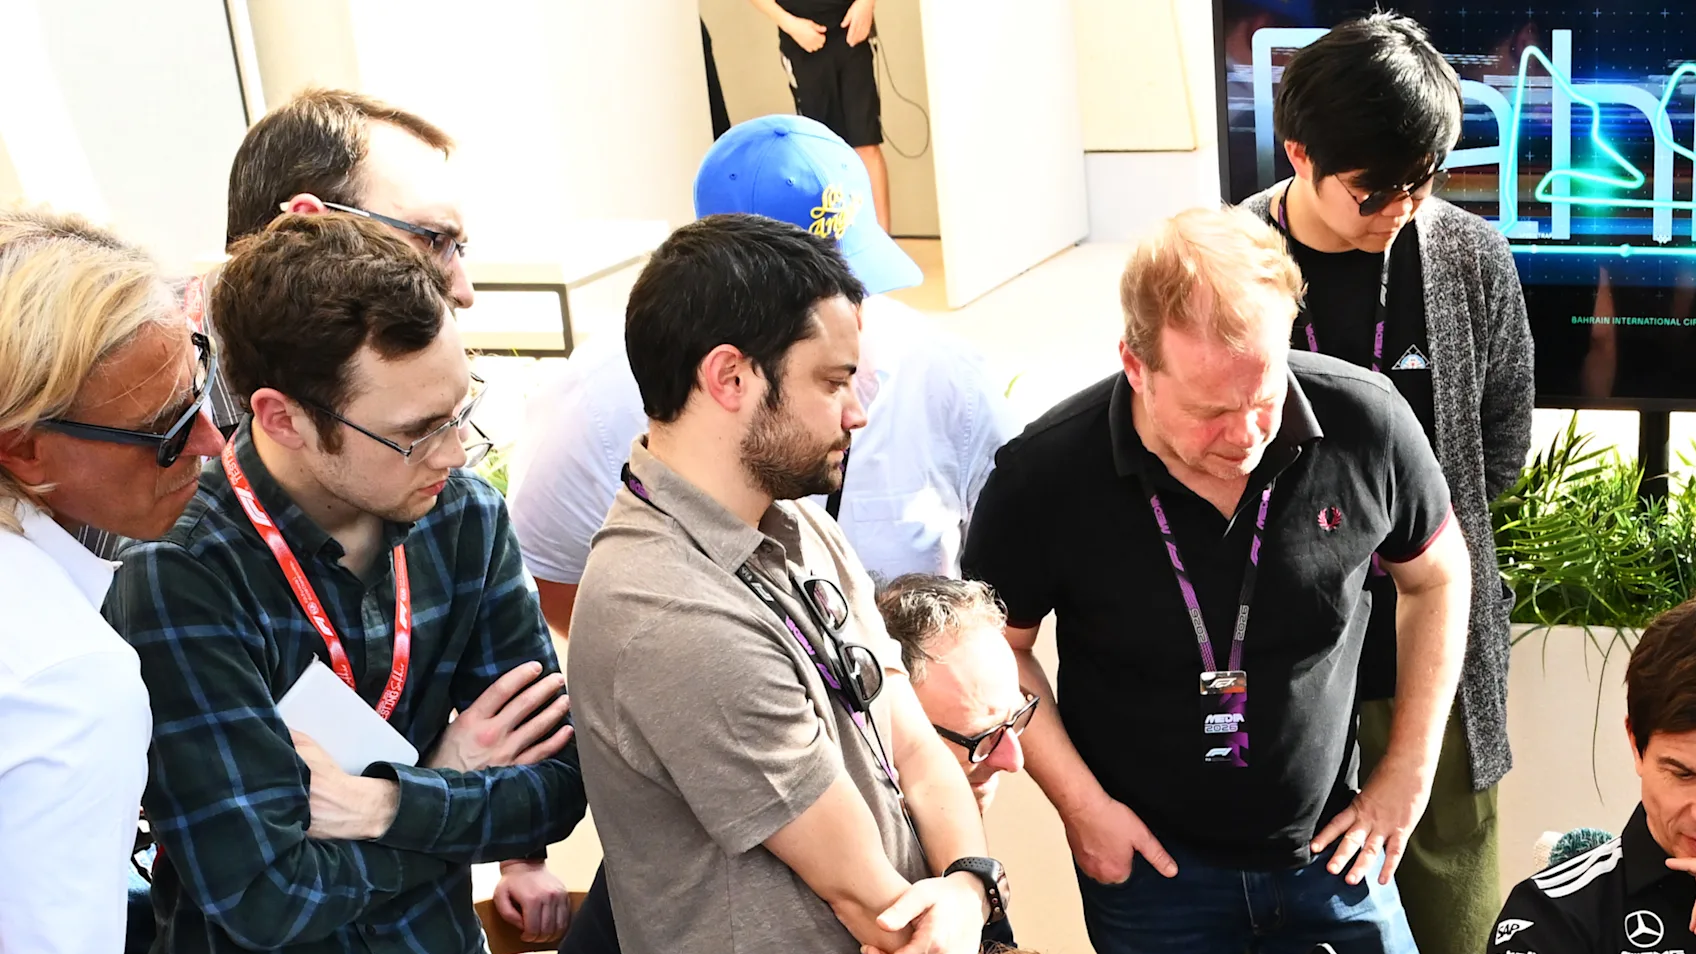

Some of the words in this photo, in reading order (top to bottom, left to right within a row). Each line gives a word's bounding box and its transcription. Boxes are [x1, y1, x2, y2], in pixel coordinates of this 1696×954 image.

[1571, 315, 1611, 325] BAHRAIN
[1612, 316, 1681, 326] INTERNATIONAL
[1233, 604, 1250, 642] 2026
[379, 690, 400, 721] ESTING
[1204, 713, 1245, 723] MEDIA
[1205, 723, 1239, 733] 2026
[1497, 923, 1520, 940] SAP
